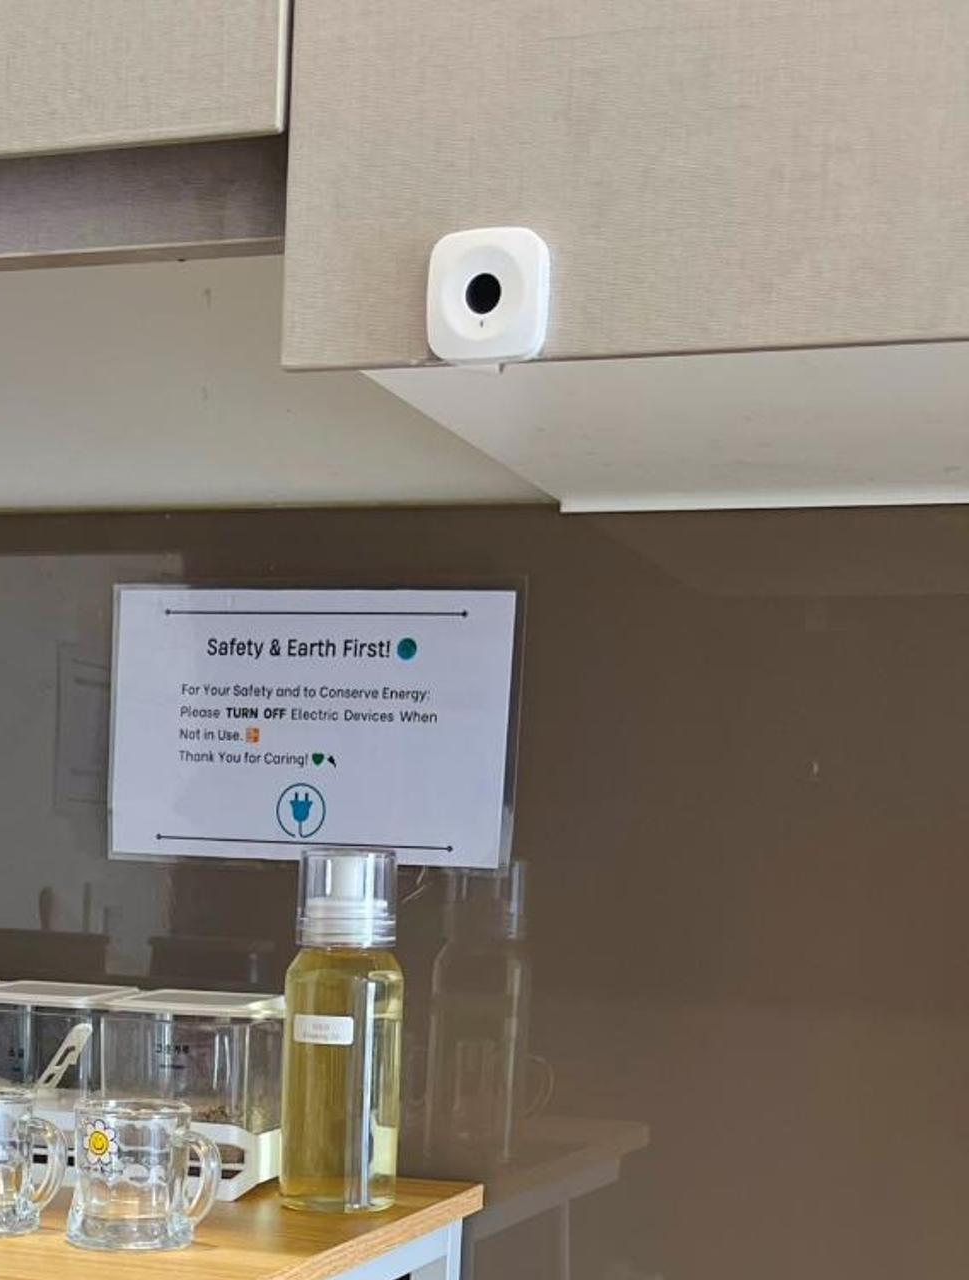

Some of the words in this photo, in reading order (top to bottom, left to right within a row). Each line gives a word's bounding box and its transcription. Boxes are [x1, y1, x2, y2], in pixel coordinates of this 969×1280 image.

[206, 638, 264, 660] Safety
[269, 638, 281, 657] &
[287, 638, 337, 658] Earth
[343, 638, 392, 658] First!
[181, 683, 200, 696] For
[203, 684, 230, 697] Your
[233, 685, 273, 700] Safety
[276, 686, 301, 698] and
[303, 686, 317, 698] to
[319, 686, 379, 700] Conserve
[382, 687, 431, 703] Energy:
[179, 705, 221, 719] Please
[226, 707, 259, 719] TURN
[263, 707, 286, 719] OFF
[291, 708, 339, 721] Electric
[344, 709, 394, 722] Devices
[399, 711, 438, 723] When
[179, 728, 201, 740] Not
[204, 729, 215, 740] in
[217, 730, 244, 741] Use.
[179, 750, 214, 762] Thank
[217, 752, 241, 763] You
[244, 752, 262, 763] for
[263, 752, 309, 768] Caring!
